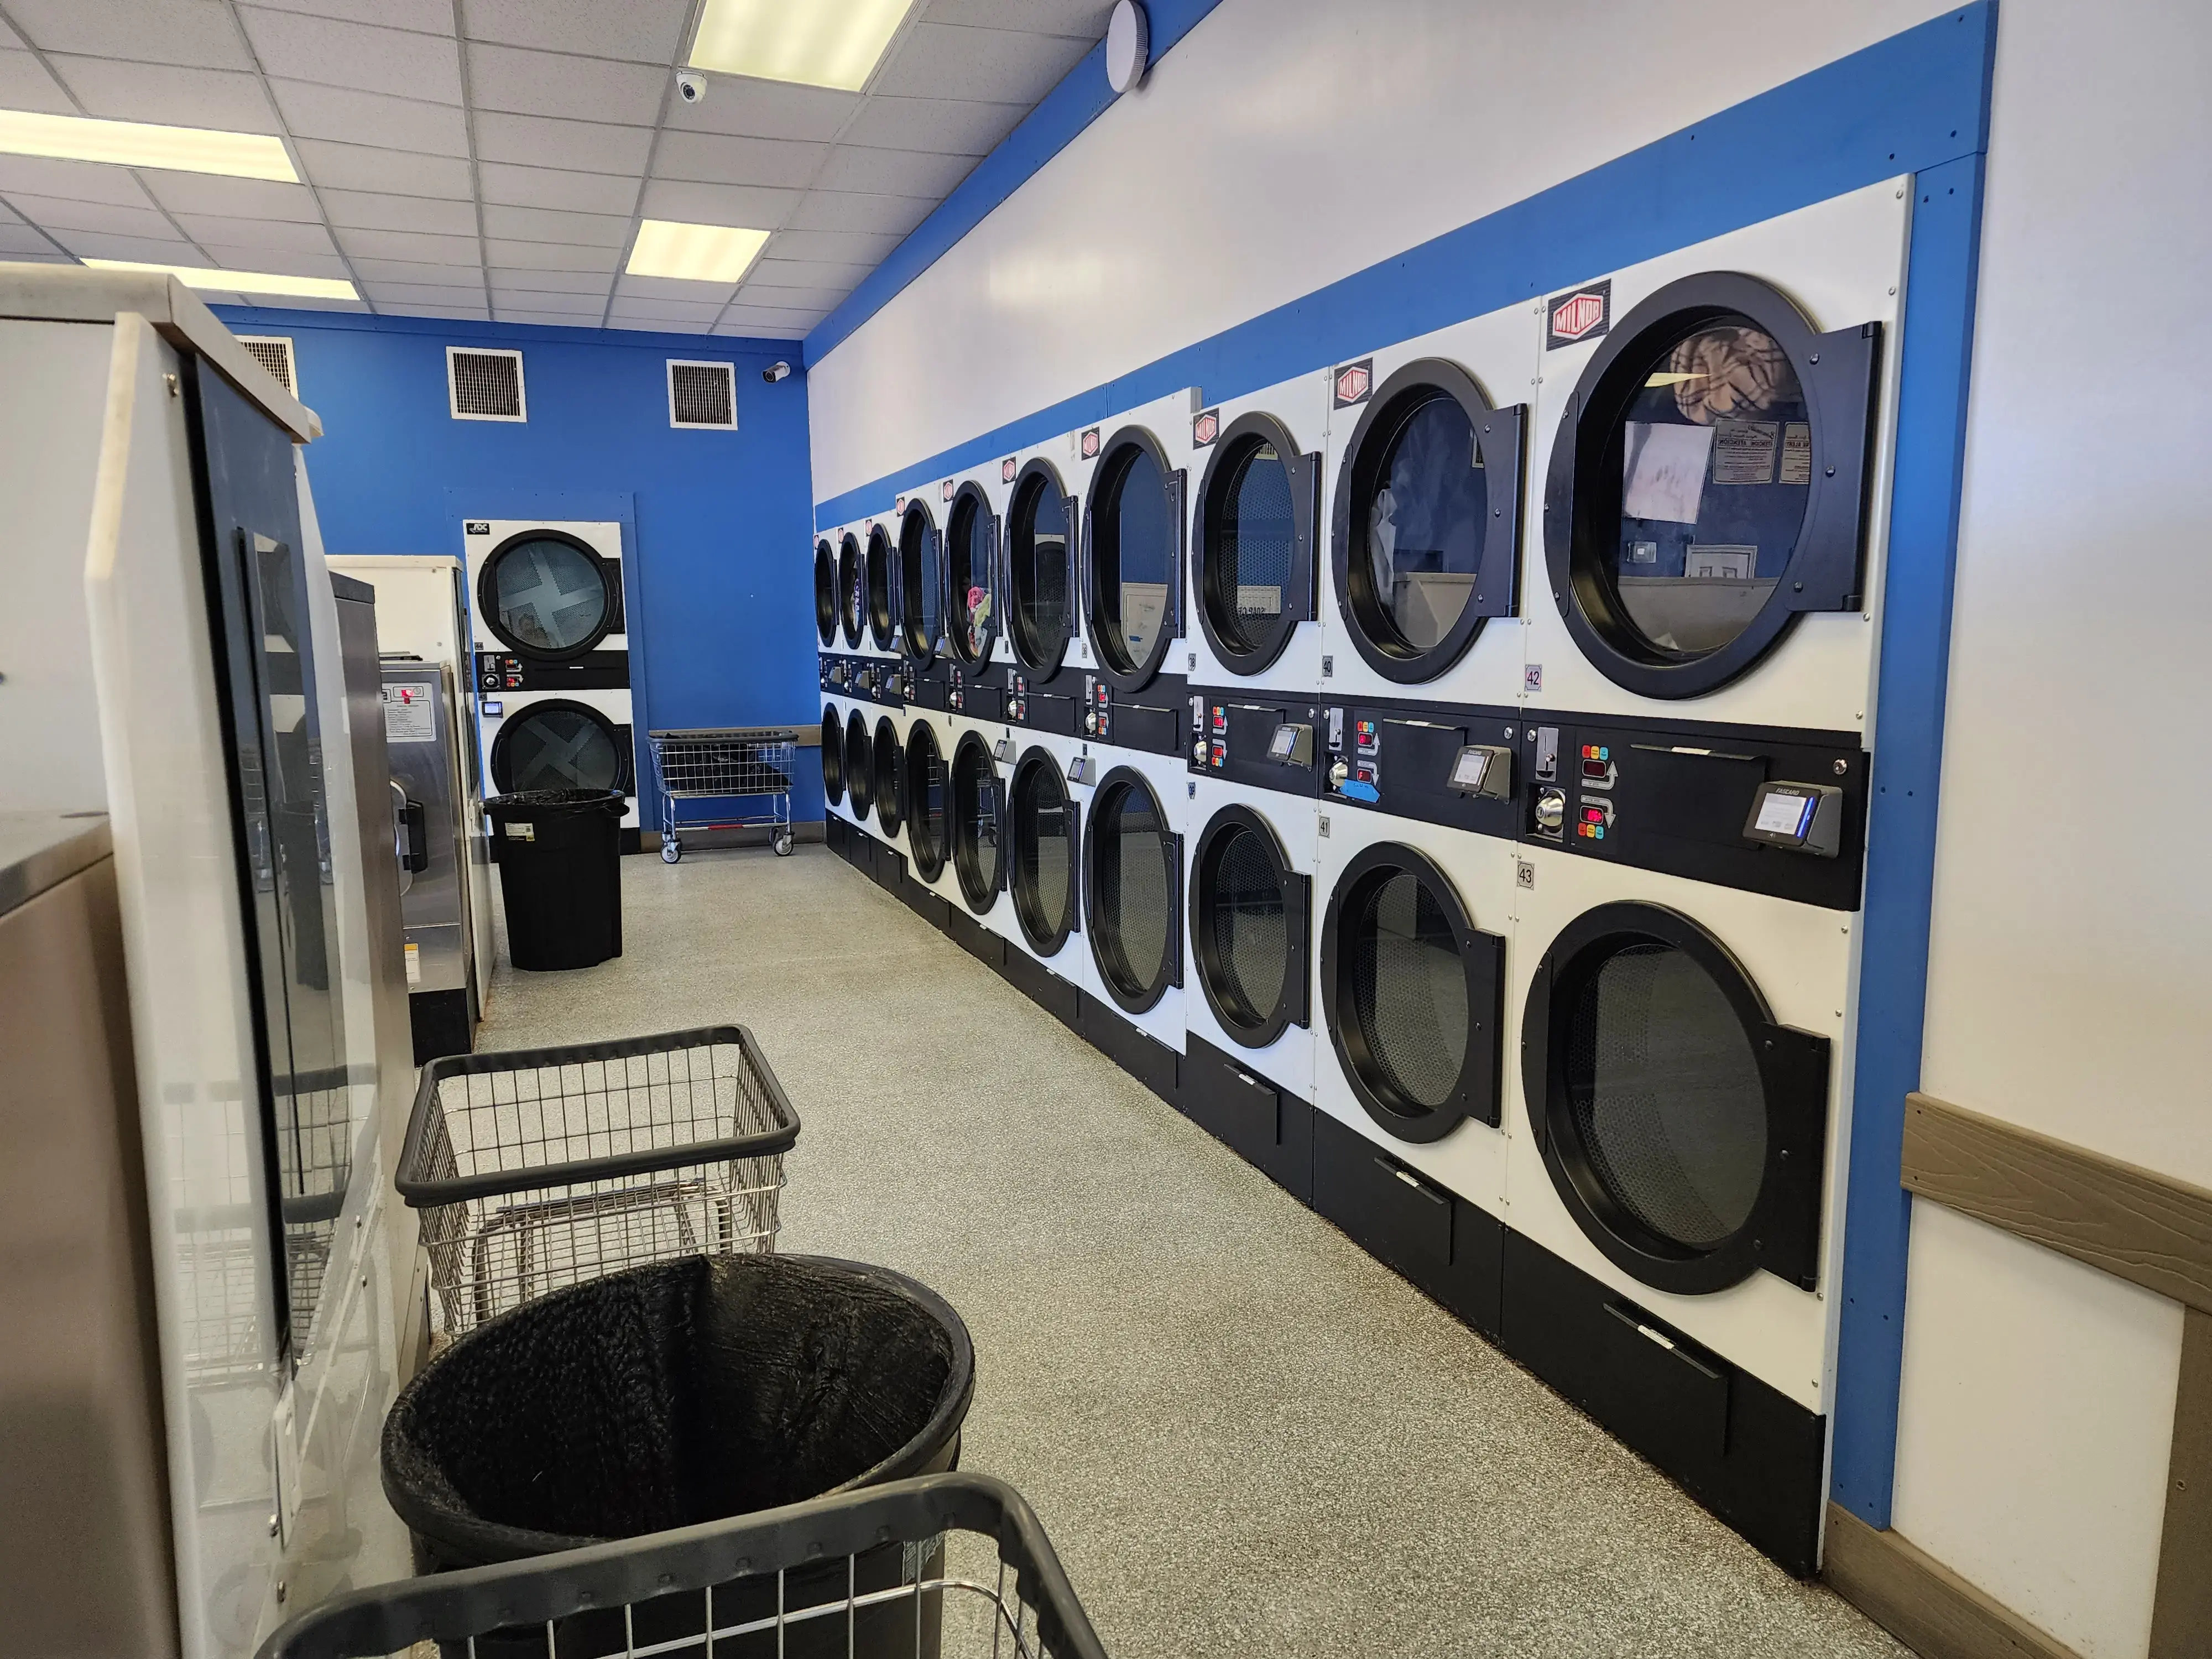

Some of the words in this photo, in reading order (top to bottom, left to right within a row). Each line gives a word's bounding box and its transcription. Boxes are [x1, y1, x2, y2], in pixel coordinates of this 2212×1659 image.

[1189, 657, 1195, 667] 38
[1323, 660, 1331, 673] 40
[1527, 671, 1539, 685] 42
[1775, 787, 1800, 796] FASCARD
[1321, 821, 1328, 833] 41
[1519, 868, 1532, 883] 43
